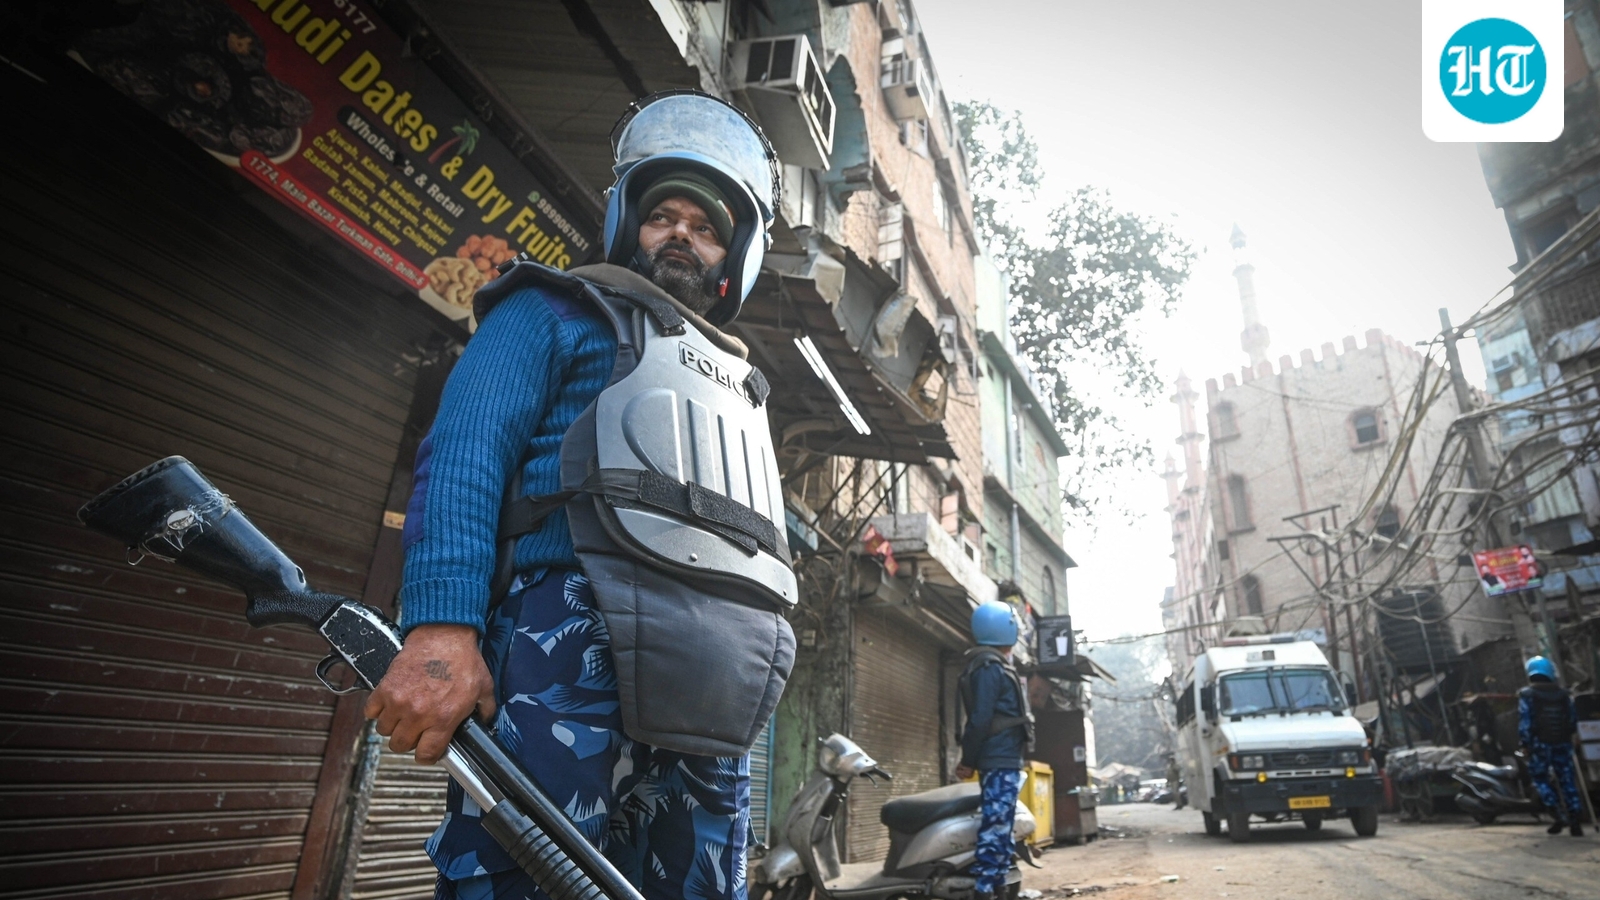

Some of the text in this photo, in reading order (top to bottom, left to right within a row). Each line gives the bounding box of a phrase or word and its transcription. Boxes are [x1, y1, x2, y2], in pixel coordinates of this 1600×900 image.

[280, 178, 308, 204] Main
[339, 50, 438, 152] Dates
[440, 155, 463, 181] &
[461, 164, 514, 224] Dry
[504, 205, 571, 271] Fruits
[346, 112, 465, 219] Wholese & Retail
